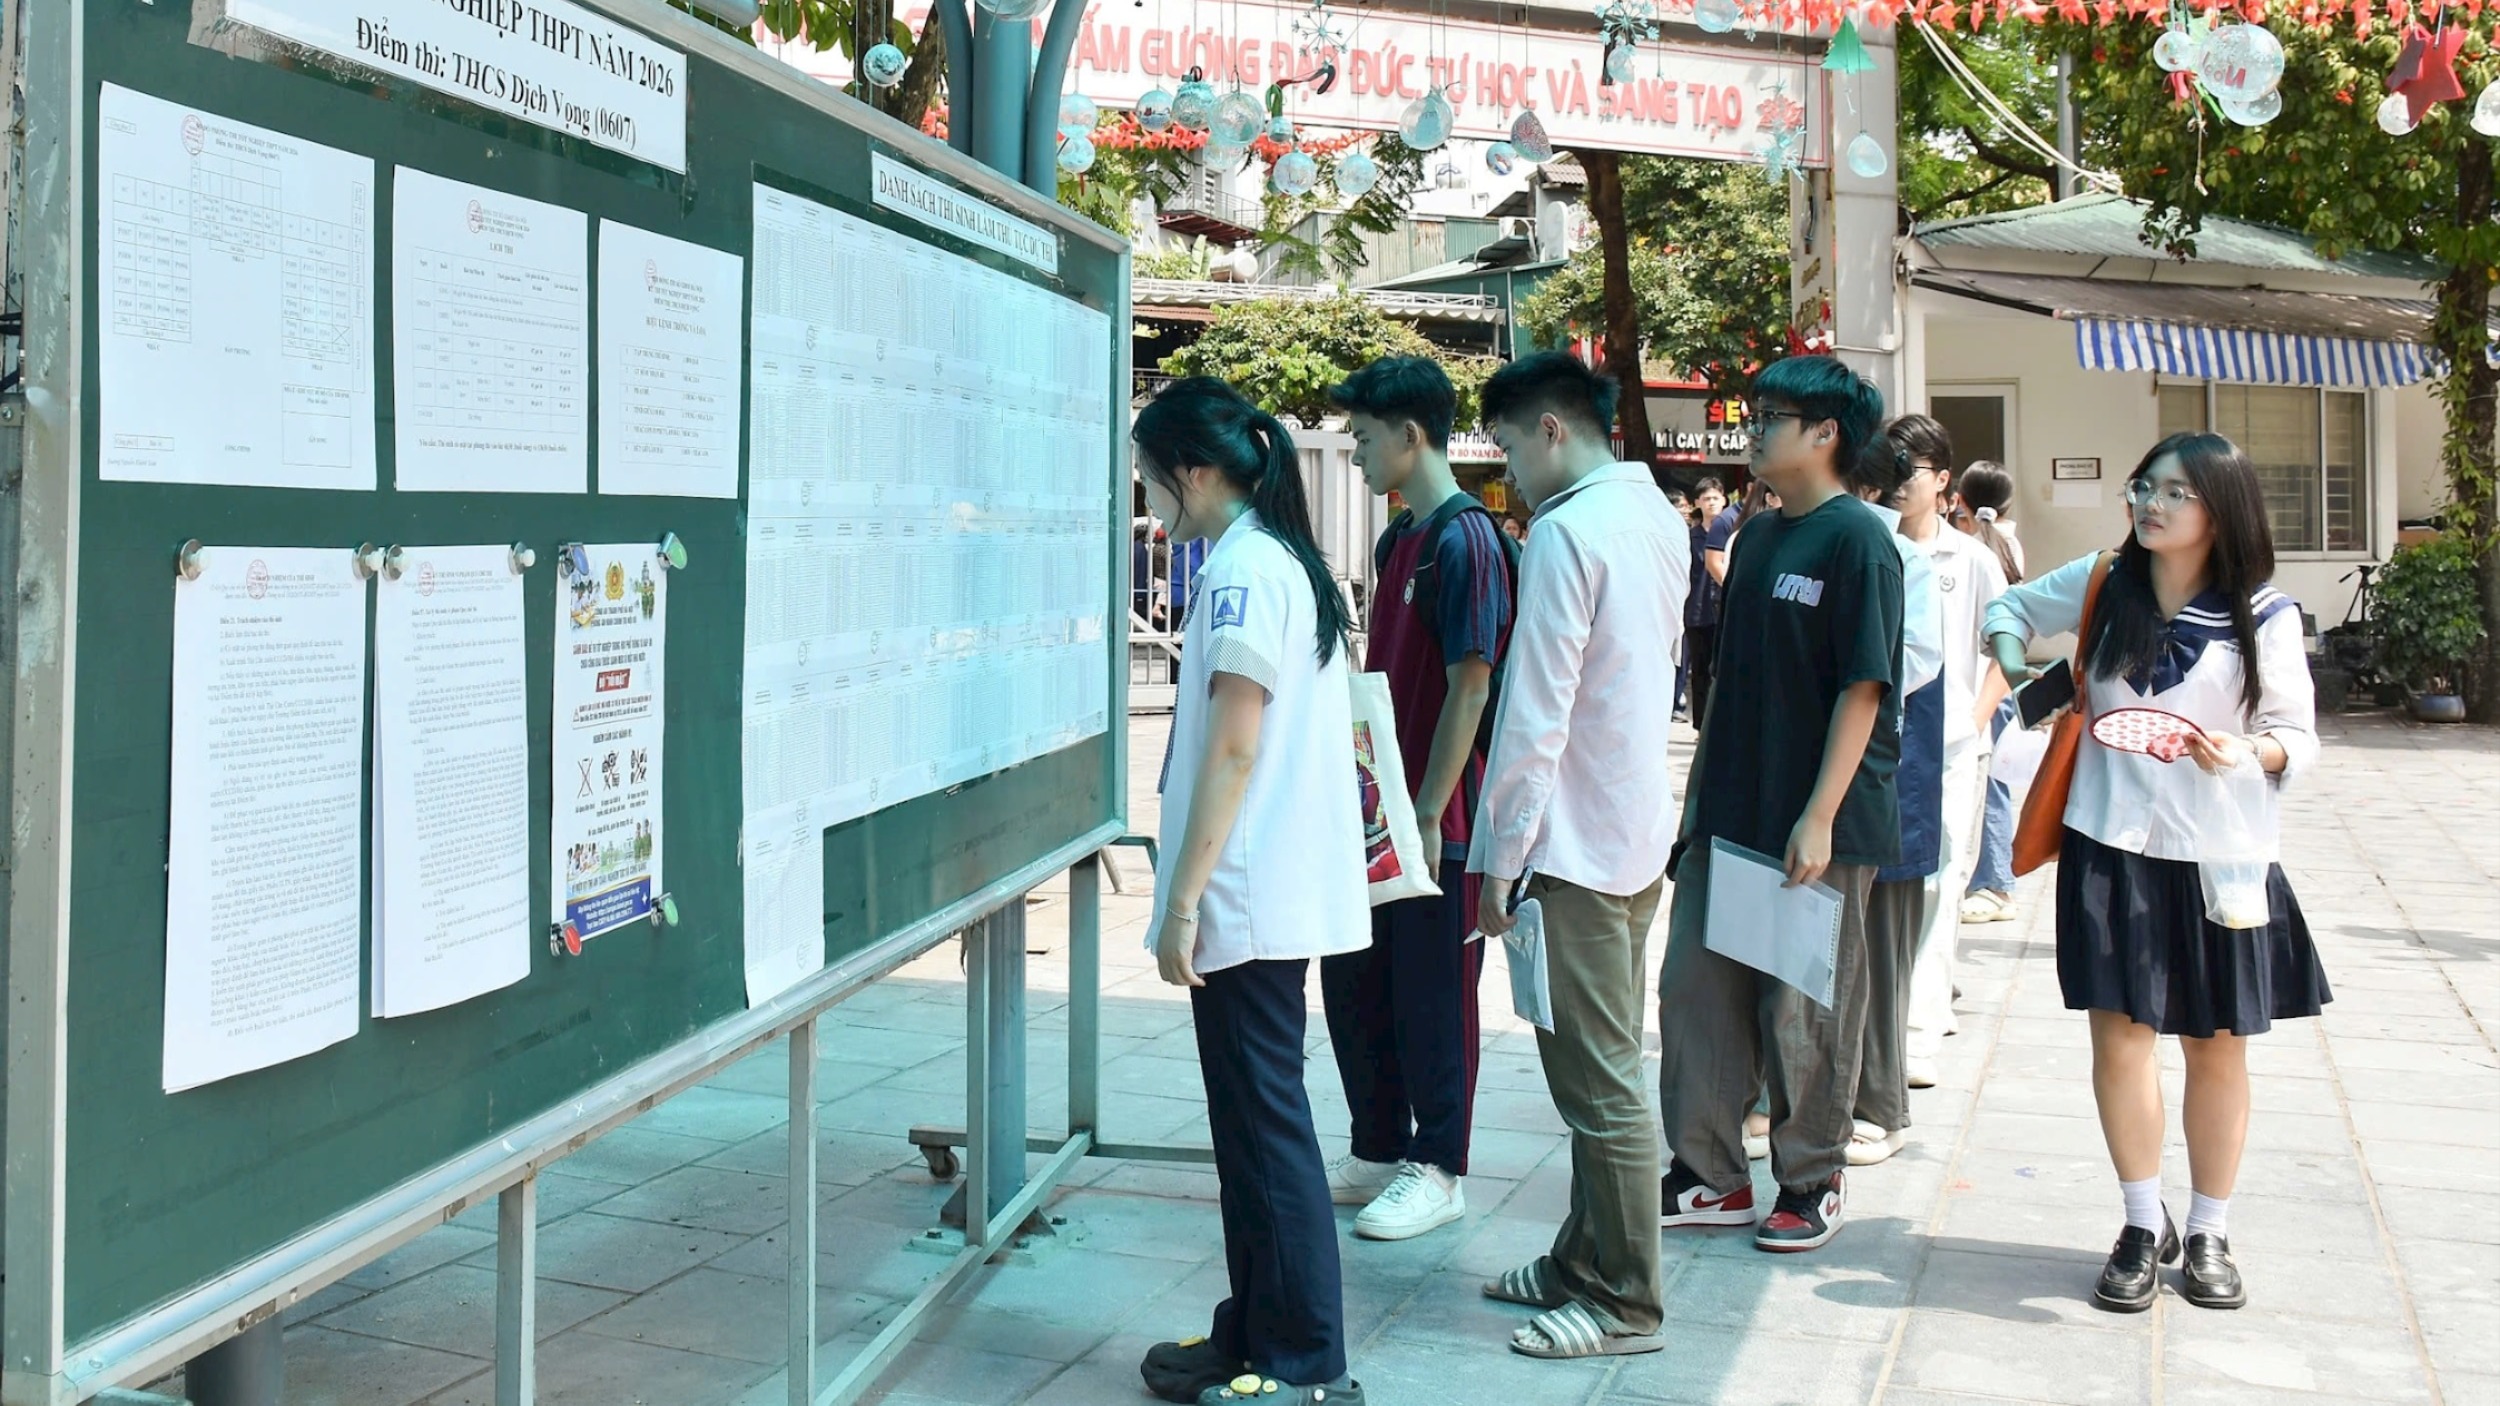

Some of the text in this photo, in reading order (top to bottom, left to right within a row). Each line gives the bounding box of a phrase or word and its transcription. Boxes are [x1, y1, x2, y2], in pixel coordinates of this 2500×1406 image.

[355, 16, 637, 150] Điểm thi: THCS Dịch Vọng (0607)
[528, 8, 587, 60] THPT
[588, 33, 634, 80] NĂM
[639, 55, 674, 98] 2026
[1067, 3, 1132, 73] ẤM
[1140, 27, 1261, 86] GƯƠNG
[1349, 40, 1423, 99] ĐỨC,
[1476, 61, 1537, 118] HỌC
[1546, 59, 1590, 116] VÀ
[1686, 83, 1743, 140] TẠO
[879, 170, 908, 203] DANH
[910, 179, 936, 217] SÁCH
[938, 194, 954, 222] THÍ
[955, 206, 976, 231] SINH
[1676, 432, 1704, 449] CAY
[1707, 434, 1716, 449] 7
[1720, 427, 1748, 450] CẤP
[1708, 399, 1749, 423] SE
